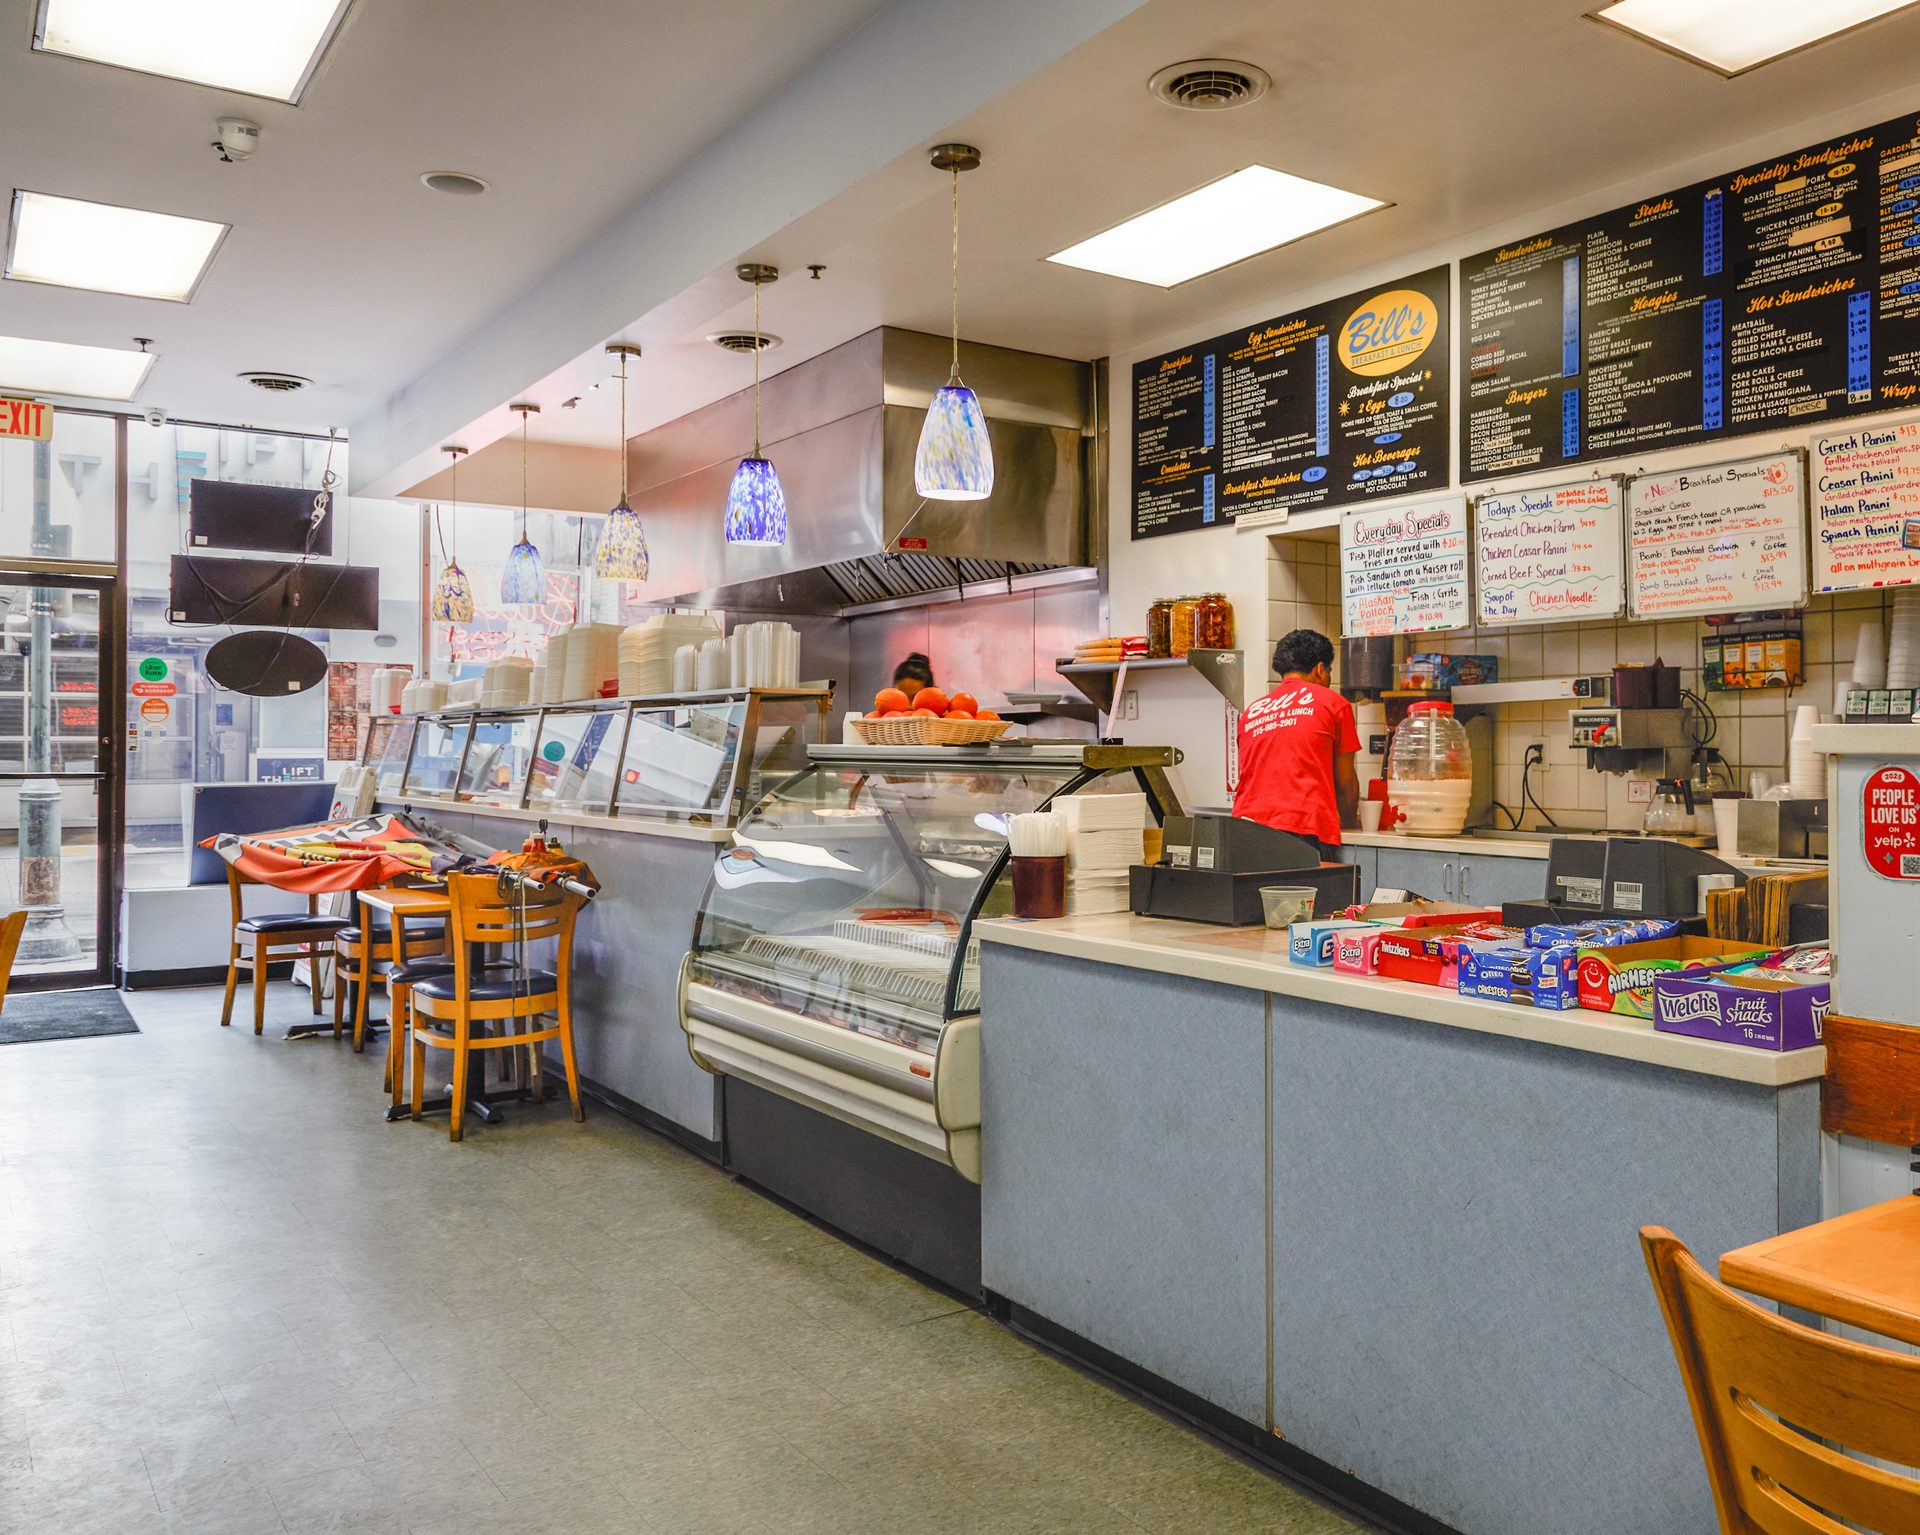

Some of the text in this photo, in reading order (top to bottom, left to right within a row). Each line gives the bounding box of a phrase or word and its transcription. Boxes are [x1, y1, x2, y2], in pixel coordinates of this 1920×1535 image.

[1880, 143, 1911, 158] GARDEN
[1730, 137, 1873, 193] Specialty Sandwiches
[1744, 174, 1825, 204] ROASTED PORK
[1880, 183, 1899, 195] CHEF
[1635, 199, 1673, 219] Steaks
[1756, 213, 1813, 234] CHICKEN CUTLET
[1880, 218, 1913, 232] SPINACH
[1587, 231, 1604, 240] PLAIN
[1495, 239, 1552, 263] Sandwiches
[1587, 240, 1622, 254] MUSHROOM
[1880, 241, 1903, 252] GREEK
[1755, 246, 1813, 267] SPINACH PANINI
[1631, 291, 1678, 312] Hoagies
[1747, 278, 1855, 313] Hot Sandwiches
[1880, 289, 1899, 298] TUNA
[1247, 319, 1307, 345] Egg Sandwiches
[1348, 304, 1427, 353] Bill's
[1589, 327, 1620, 339] AMERICAN
[1732, 319, 1765, 331] MEATBALL
[1589, 337, 1610, 347] ITALIAN
[1732, 329, 1786, 347] GRILLED CHEESE
[1352, 350, 1388, 366] BREAKFAST
[1398, 341, 1422, 353] LUNCH
[1160, 355, 1192, 373] Breakfast
[1732, 366, 1775, 381] CRAB CAKES
[1347, 370, 1423, 398] Breakfast Special
[1732, 381, 1787, 397] FRIED FLOUNDER
[1881, 384, 1916, 399] Wrap
[1506, 388, 1547, 405] Burgers
[1732, 385, 1811, 406] CHICKEN PARMIGIANA
[1358, 398, 1386, 415] 2 Eggs
[1471, 407, 1503, 419] HAMBURGER
[1732, 412, 1759, 423] PEPPERS
[1767, 406, 1788, 416] EGGS
[1790, 401, 1821, 414] Cheese
[1819, 439, 1857, 456] Greek
[1862, 431, 1896, 446] Panini
[1353, 447, 1421, 467] Hot Beverages
[1161, 462, 1190, 475] Omelettes
[1726, 467, 1765, 481] Specials
[1223, 474, 1300, 495] Breakfast Sandwiches
[1819, 469, 1893, 492] Ceasar Panini
[1556, 487, 1607, 498] includes fries
[1566, 498, 1586, 506] pasta
[1587, 496, 1608, 504] salad
[1482, 494, 1552, 517] Todays Specials
[1820, 498, 1890, 520] Italian Panini
[1353, 510, 1450, 545] Everyday Specials
[1482, 518, 1575, 542] Breaded Chicken Parm
[1821, 521, 1899, 544] Spinach Panini
[1350, 552, 1366, 561] Fish
[1396, 543, 1420, 554] served
[1423, 539, 1440, 550] with
[1481, 541, 1567, 562] Chicken Ceasar Panini
[1671, 544, 1739, 558] Breakfast Sandwich
[1364, 560, 1382, 568] Fries
[1400, 551, 1432, 562] coleslaw
[1831, 560, 1842, 573] all
[1350, 575, 1364, 584] Fish
[1367, 569, 1400, 582] Sandwich
[1423, 563, 1447, 574] Kaiser
[1450, 560, 1464, 570] roll
[1482, 564, 1566, 584] Corned Beef Special
[1350, 578, 1416, 593] with lettuce tomato
[1410, 587, 1459, 601] Fish Grits
[1359, 595, 1395, 607] Alaskan
[1484, 591, 1513, 604] Soup of
[1530, 590, 1564, 607] Chicken
[1360, 606, 1394, 618] Pollock
[1484, 606, 1517, 615] the Day
[1248, 687, 1314, 719] Bill's
[1245, 712, 1279, 732] BREAKFAST
[1287, 708, 1314, 716] LUNCH
[283, 767, 314, 776] LIFT
[1872, 789, 1915, 805] PEOPLE
[1871, 808, 1916, 824] LOVE US
[1874, 835, 1902, 848] yelp
[1294, 938, 1310, 951] Extra
[1381, 940, 1410, 957] Twizzlers
[1341, 948, 1361, 960] Extra
[1608, 968, 1672, 993] AIRHEA
[1477, 984, 1508, 998] CAKESTERS
[1662, 994, 1719, 1018] Welch's
[1735, 998, 1767, 1010] Fruit
[1726, 1008, 1773, 1023] Snacks
[1743, 1028, 1753, 1038] 16
